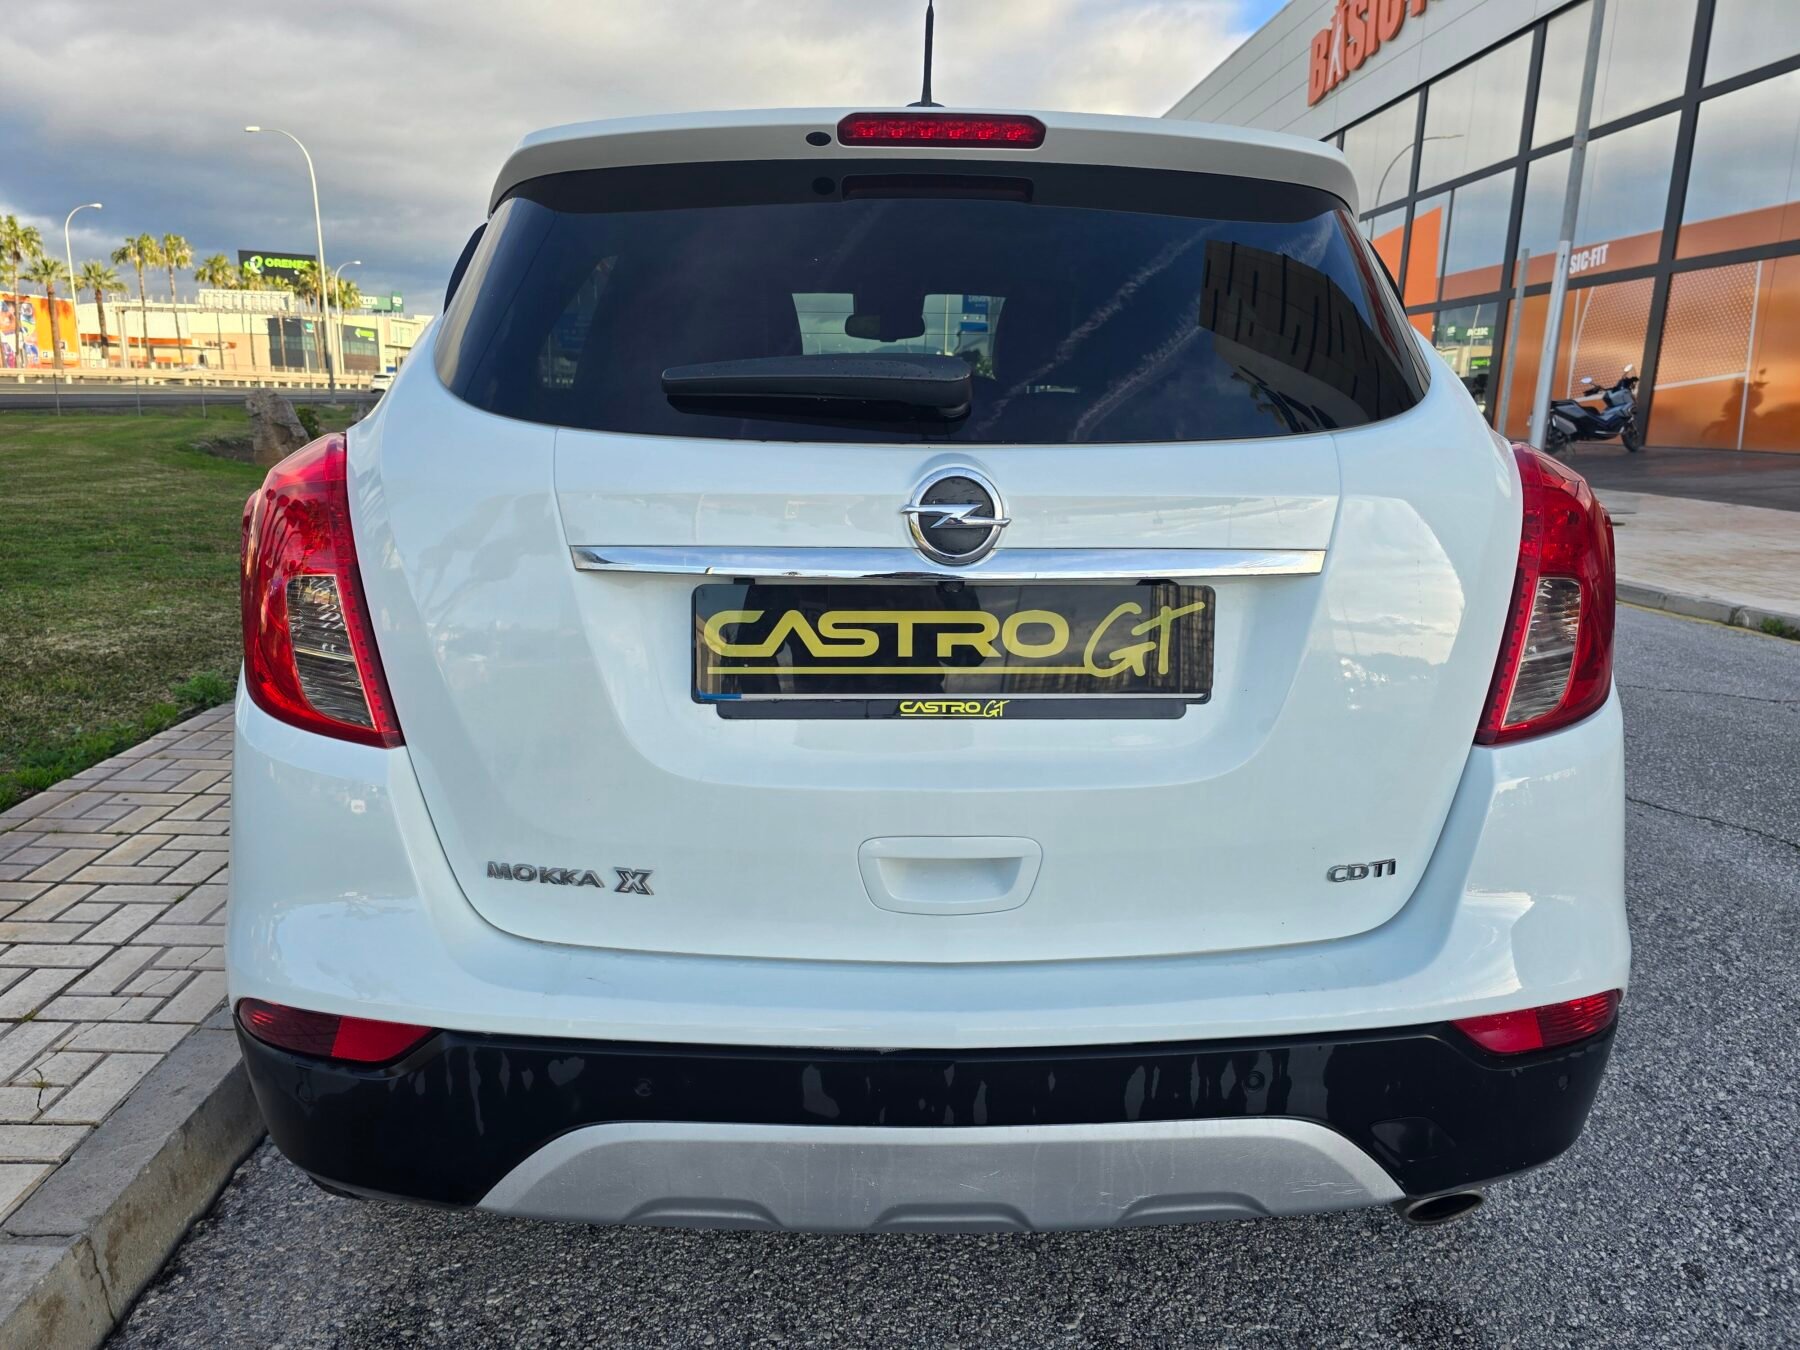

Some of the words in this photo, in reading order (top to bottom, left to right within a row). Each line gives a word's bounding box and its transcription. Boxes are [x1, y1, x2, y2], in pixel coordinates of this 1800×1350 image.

[704, 609, 1069, 658] CASTRO
[1083, 601, 1205, 678] GT
[900, 701, 980, 713] CASTRO
[487, 861, 605, 888] MOKKA
[613, 867, 654, 895] X
[1327, 858, 1396, 882] CDTI
